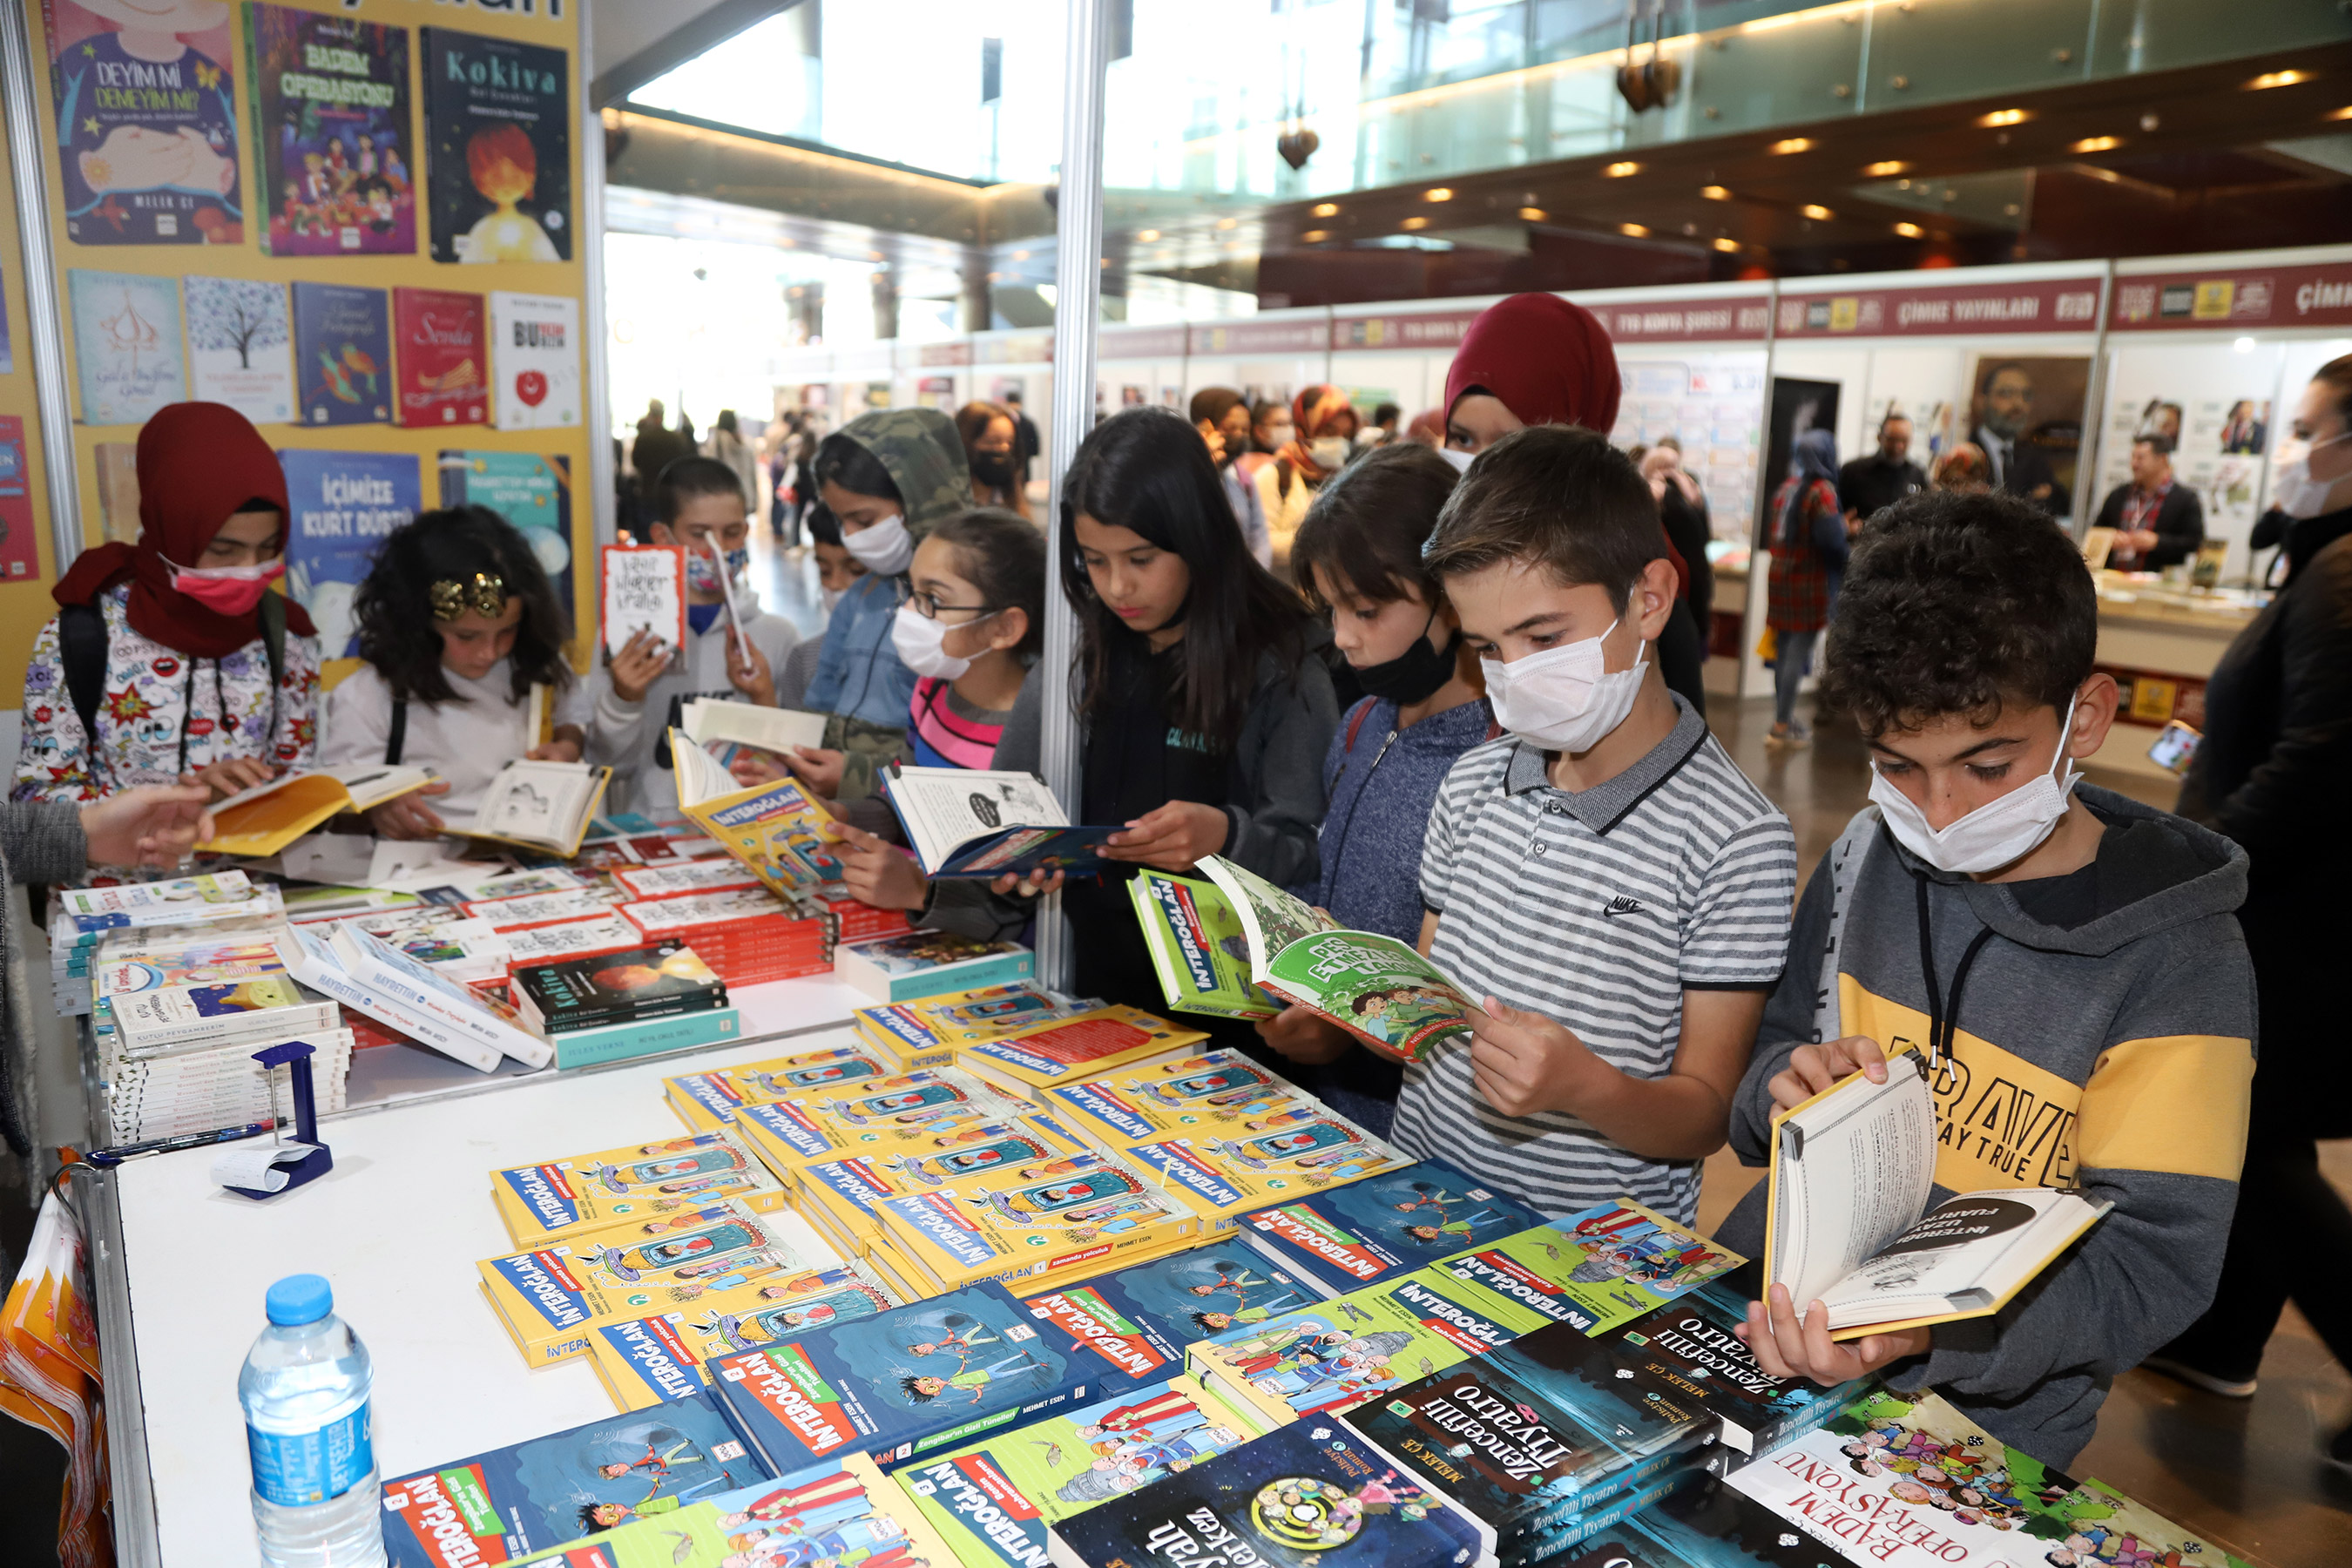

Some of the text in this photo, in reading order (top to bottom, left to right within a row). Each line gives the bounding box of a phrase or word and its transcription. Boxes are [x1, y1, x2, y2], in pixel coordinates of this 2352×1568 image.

[97, 61, 157, 87] DEYİM
[305, 44, 370, 76] BADEM
[95, 88, 171, 110] DEMEYİM
[280, 71, 394, 107] OPERASYONU
[1897, 301, 1950, 328] ÇİMKE
[1953, 296, 2040, 321] YAYINLARI
[322, 473, 395, 510] İÇİMİZE
[302, 511, 354, 537] KURT
[716, 788, 803, 825] İNTEROĞLAN
[1612, 895, 1641, 912] NIKE
[1156, 879, 1213, 989] İNTEROĞLAN
[1313, 937, 1354, 961] PES
[317, 974, 364, 1003] HAYRETTİN
[373, 972, 419, 999] HAYRETTİN
[137, 1024, 226, 1042] KUTLU PEYGAMBERİM
[872, 1006, 939, 1048] İNTEROĞLAN
[980, 1044, 1071, 1077] İNTEROĞLAN
[751, 1104, 824, 1157] İNTEROĞLAN
[1063, 1084, 1155, 1139] İNTEROĞLAN
[1138, 1145, 1240, 1206] İNTEROĞLAN
[1980, 1135, 2031, 1182] TRUE
[513, 1167, 576, 1229] İNTEROĞLAN
[900, 1192, 990, 1267] İNTEROĞLAN
[1052, 1254, 1083, 1267] zamanda
[1084, 1246, 1112, 1260] yolculuk
[1117, 1239, 1139, 1250] MEHMET
[1139, 1234, 1152, 1244] ESEN
[1260, 1212, 1376, 1279] İNTEROĞLAN
[505, 1254, 592, 1328] İNTEROĞLAN
[1456, 1255, 1592, 1330] İNTEROĞLAN
[1492, 1253, 1554, 1289] Kahramanlarım
[1503, 1265, 1531, 1282] Benim
[1378, 1294, 1414, 1321] MEHMET ESEN
[1572, 1293, 1611, 1319] MEHMET ESEN
[646, 1319, 700, 1365] zamanda yolculuk
[1039, 1294, 1151, 1375] İNTEROĞLAN
[1456, 1330, 1484, 1349] Benim
[608, 1321, 701, 1399] NTEROĞLAN
[731, 1369, 740, 1379] 2
[1645, 1362, 1709, 1398] MELEK ÇE
[1653, 1328, 1775, 1395] Zencefilli
[740, 1353, 844, 1449] İNTEROĞLAN
[1642, 1397, 1680, 1424] Polisiye
[1659, 1398, 1693, 1423] Roman
[1778, 1393, 1843, 1437] Zencefilli Tiyatro
[902, 1448, 909, 1456] 2
[917, 1431, 962, 1451] Zengibar'ın
[963, 1425, 982, 1440] Gizli
[983, 1412, 1017, 1433] Tünelleri
[1023, 1399, 1047, 1415] MEHMET
[1048, 1394, 1066, 1408] ESEN
[1420, 1396, 1544, 1482] Zencefilli
[1453, 1385, 1573, 1470] Tiyatro
[1324, 1446, 1361, 1478] Polisiye
[1340, 1448, 1375, 1476] Roman
[1400, 1438, 1465, 1484] MELEK ÇE
[975, 1458, 1031, 1511] Kahramanlarım
[980, 1477, 1004, 1501] Benim
[1532, 1499, 1580, 1533] Zencefilli
[1581, 1484, 1618, 1511] Tiyatro
[1636, 1459, 1659, 1481] MELEK
[1660, 1455, 1672, 1471] ÇE
[1773, 1450, 1970, 1563] OPERASYONU
[404, 1475, 491, 1568] TEROĞLAN
[923, 1461, 1050, 1568] NTEROĞLAN
[1535, 1483, 1674, 1563] Zencefilli Tiyatro MELEK ÇE
[1786, 1488, 1909, 1563] BADEM
[1146, 1518, 1228, 1568] yah
[1186, 1506, 1274, 1568] erkez
